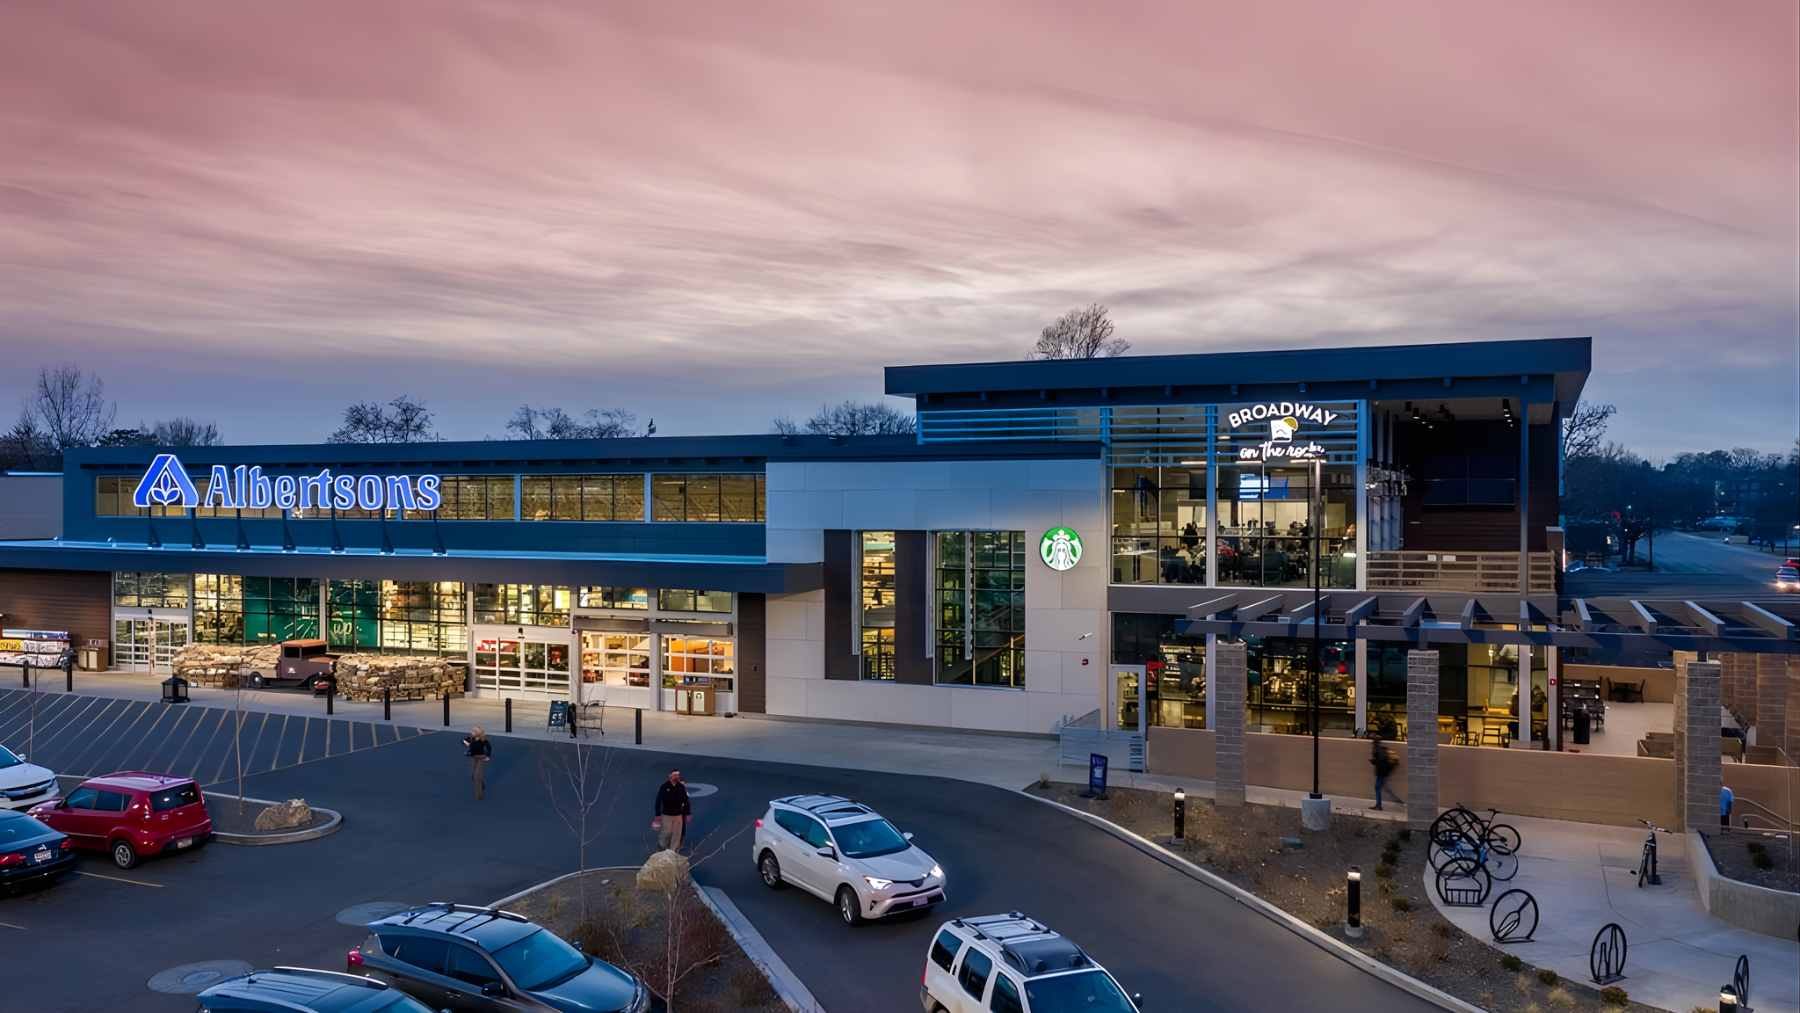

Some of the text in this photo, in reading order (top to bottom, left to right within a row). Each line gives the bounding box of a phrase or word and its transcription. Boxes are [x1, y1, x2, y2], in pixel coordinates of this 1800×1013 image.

[1229, 402, 1338, 428] BROADWAY
[1240, 447, 1259, 459] on
[1259, 441, 1285, 461] the
[204, 464, 442, 511] Albertsons
